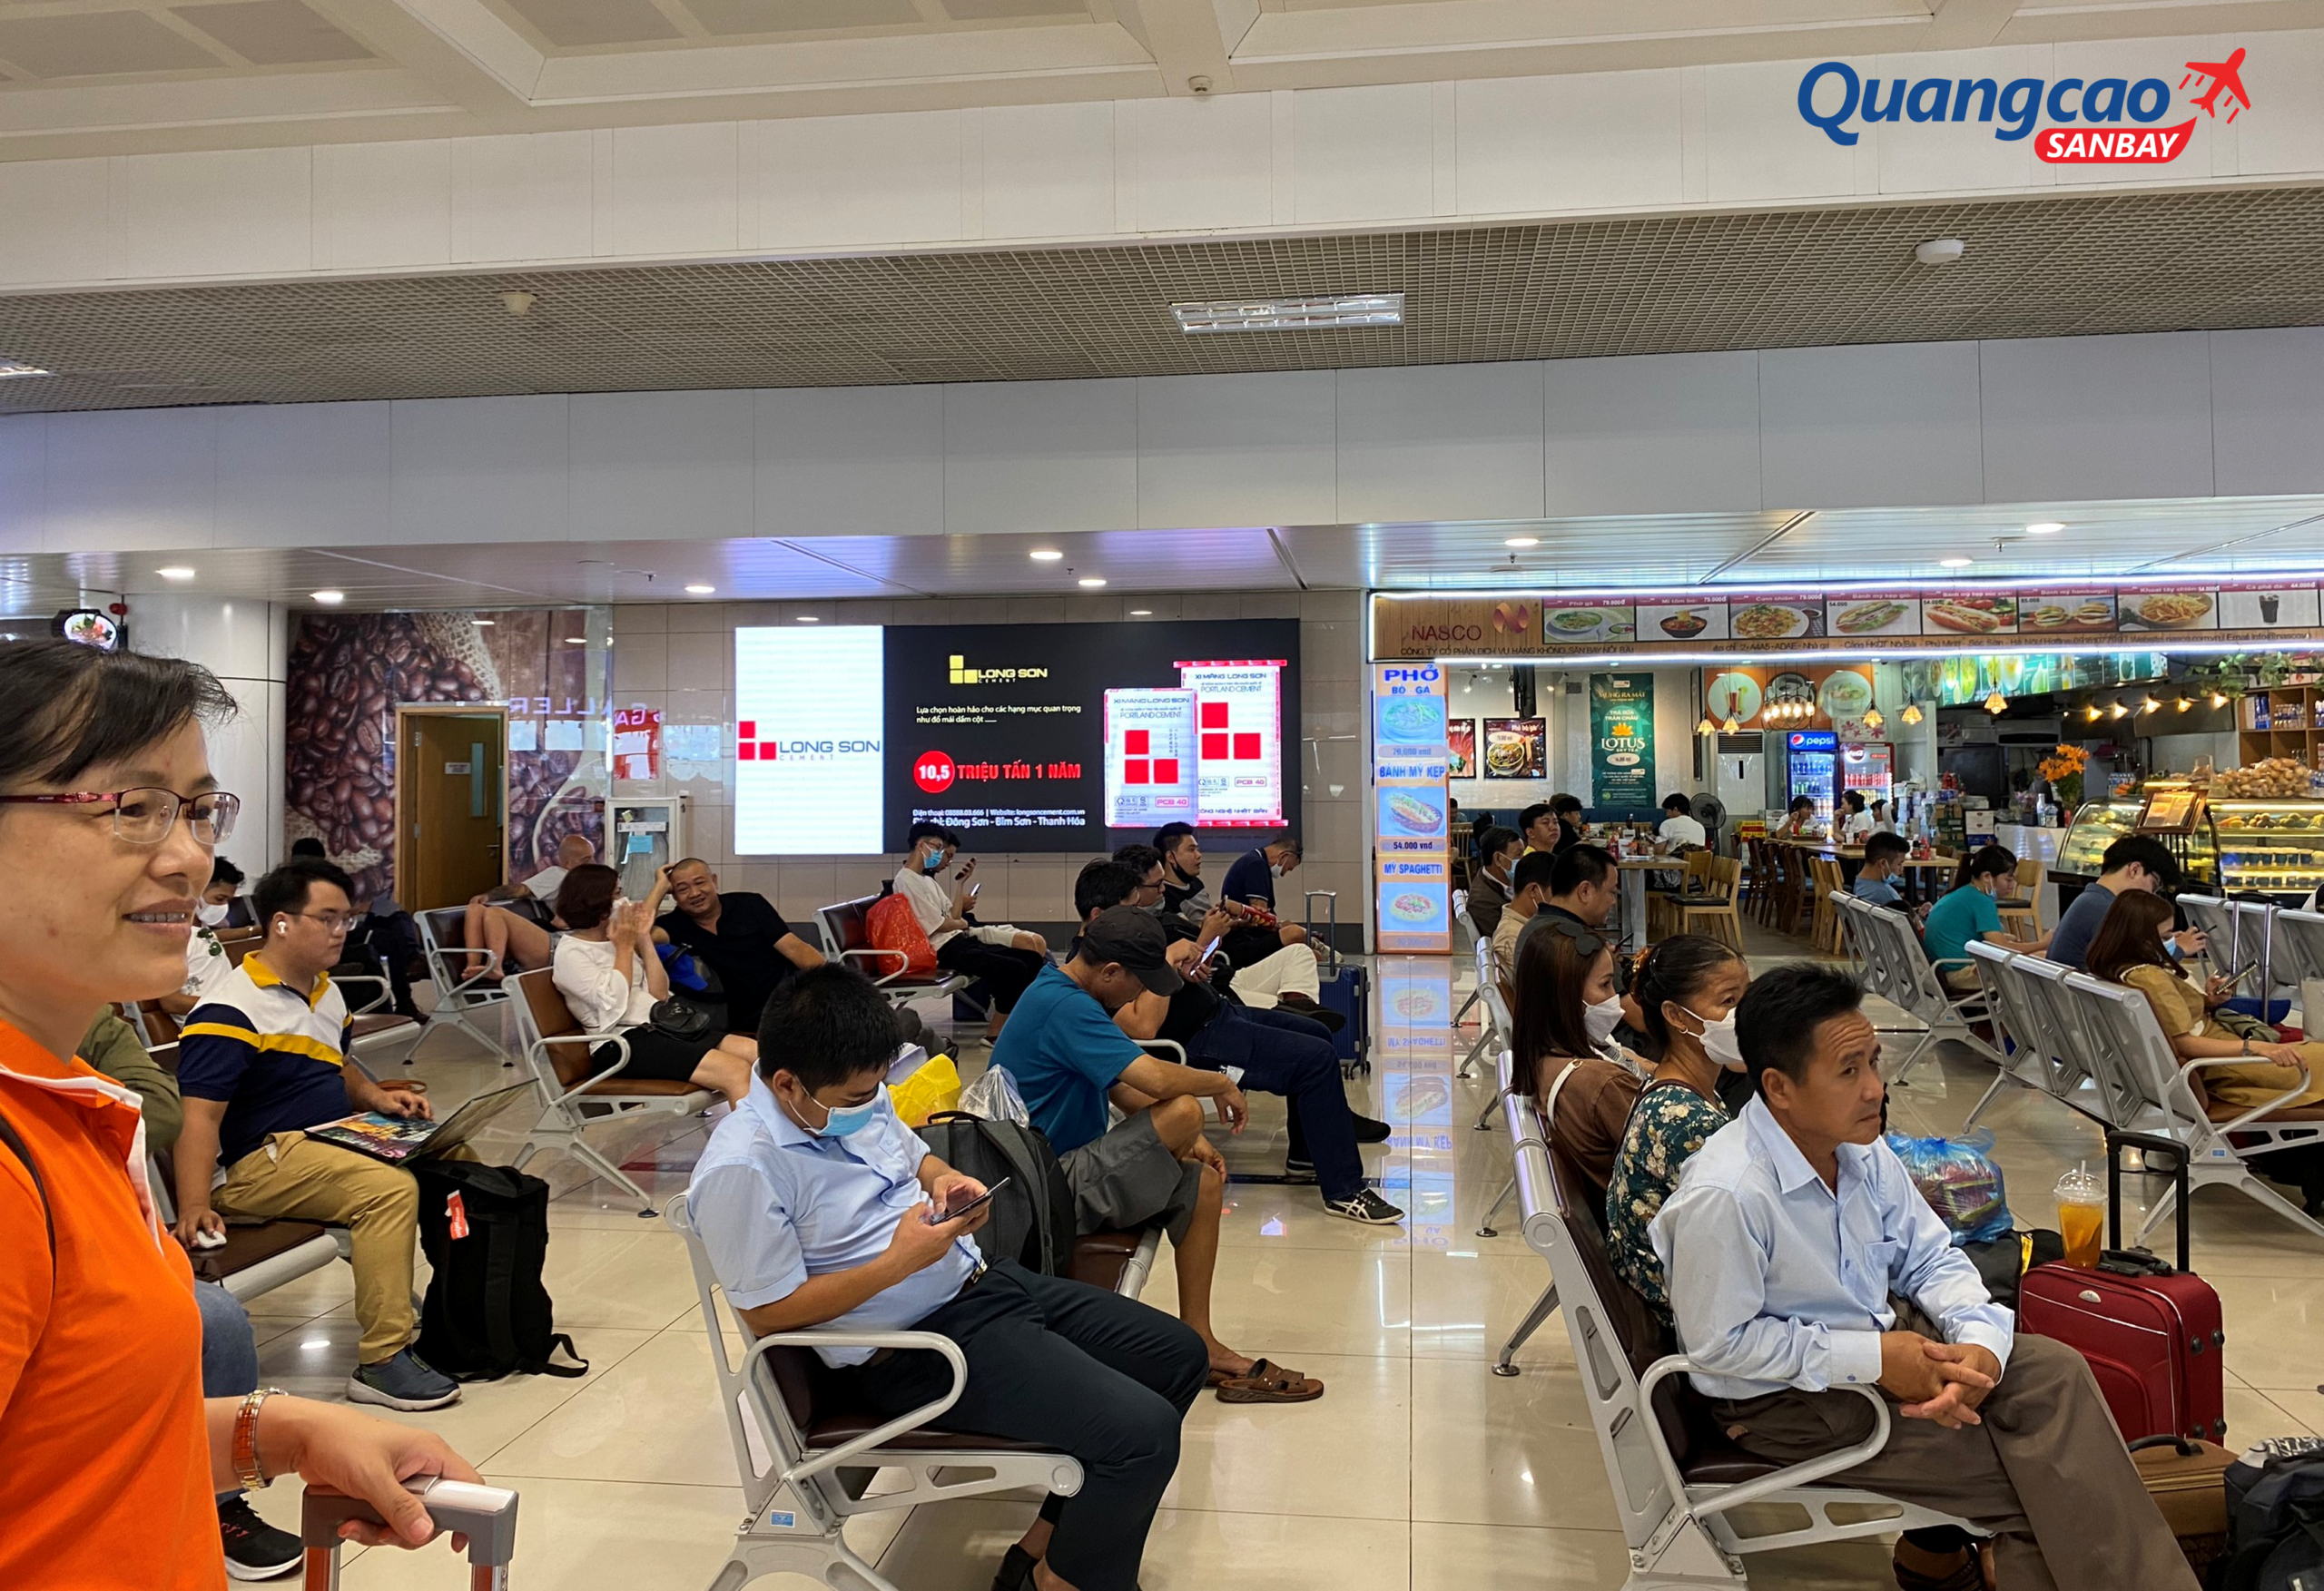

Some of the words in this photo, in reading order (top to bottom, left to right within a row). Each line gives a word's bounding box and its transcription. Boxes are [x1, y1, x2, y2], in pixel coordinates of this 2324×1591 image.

[1412, 624, 1482, 641] NASCO
[1401, 646, 1423, 655] CÔNG
[1426, 646, 1437, 655] TY
[1512, 645, 1535, 654] HÀNG
[978, 669, 1016, 679] LONG
[1018, 668, 1049, 678] SON
[1384, 664, 1440, 682] PHỞ
[1392, 684, 1406, 694] BÒ
[1415, 684, 1431, 694] GÀ
[930, 706, 947, 714] chọn
[981, 705, 995, 713] cho
[1008, 705, 1026, 714] hạng
[1062, 705, 1081, 713] trọng
[916, 715, 931, 723] như
[779, 741, 833, 753] LONG
[838, 741, 881, 752] SON
[1601, 737, 1645, 751] LOTUS
[1807, 736, 1834, 746] pepsi
[919, 764, 950, 781] 10,5
[957, 761, 999, 782] TRIỆU
[1002, 759, 1030, 779] TẤN
[1035, 764, 1042, 778] 1
[1048, 761, 1081, 779] NĂM
[1379, 763, 1406, 778] BÁNH
[945, 818, 970, 829] Đông
[971, 817, 990, 827] Sơn
[1014, 817, 1031, 827] Sơn
[1039, 817, 1066, 826] Thanh
[1068, 817, 1086, 827] Hóa
[1399, 864, 1443, 874] SPAGHETTI
